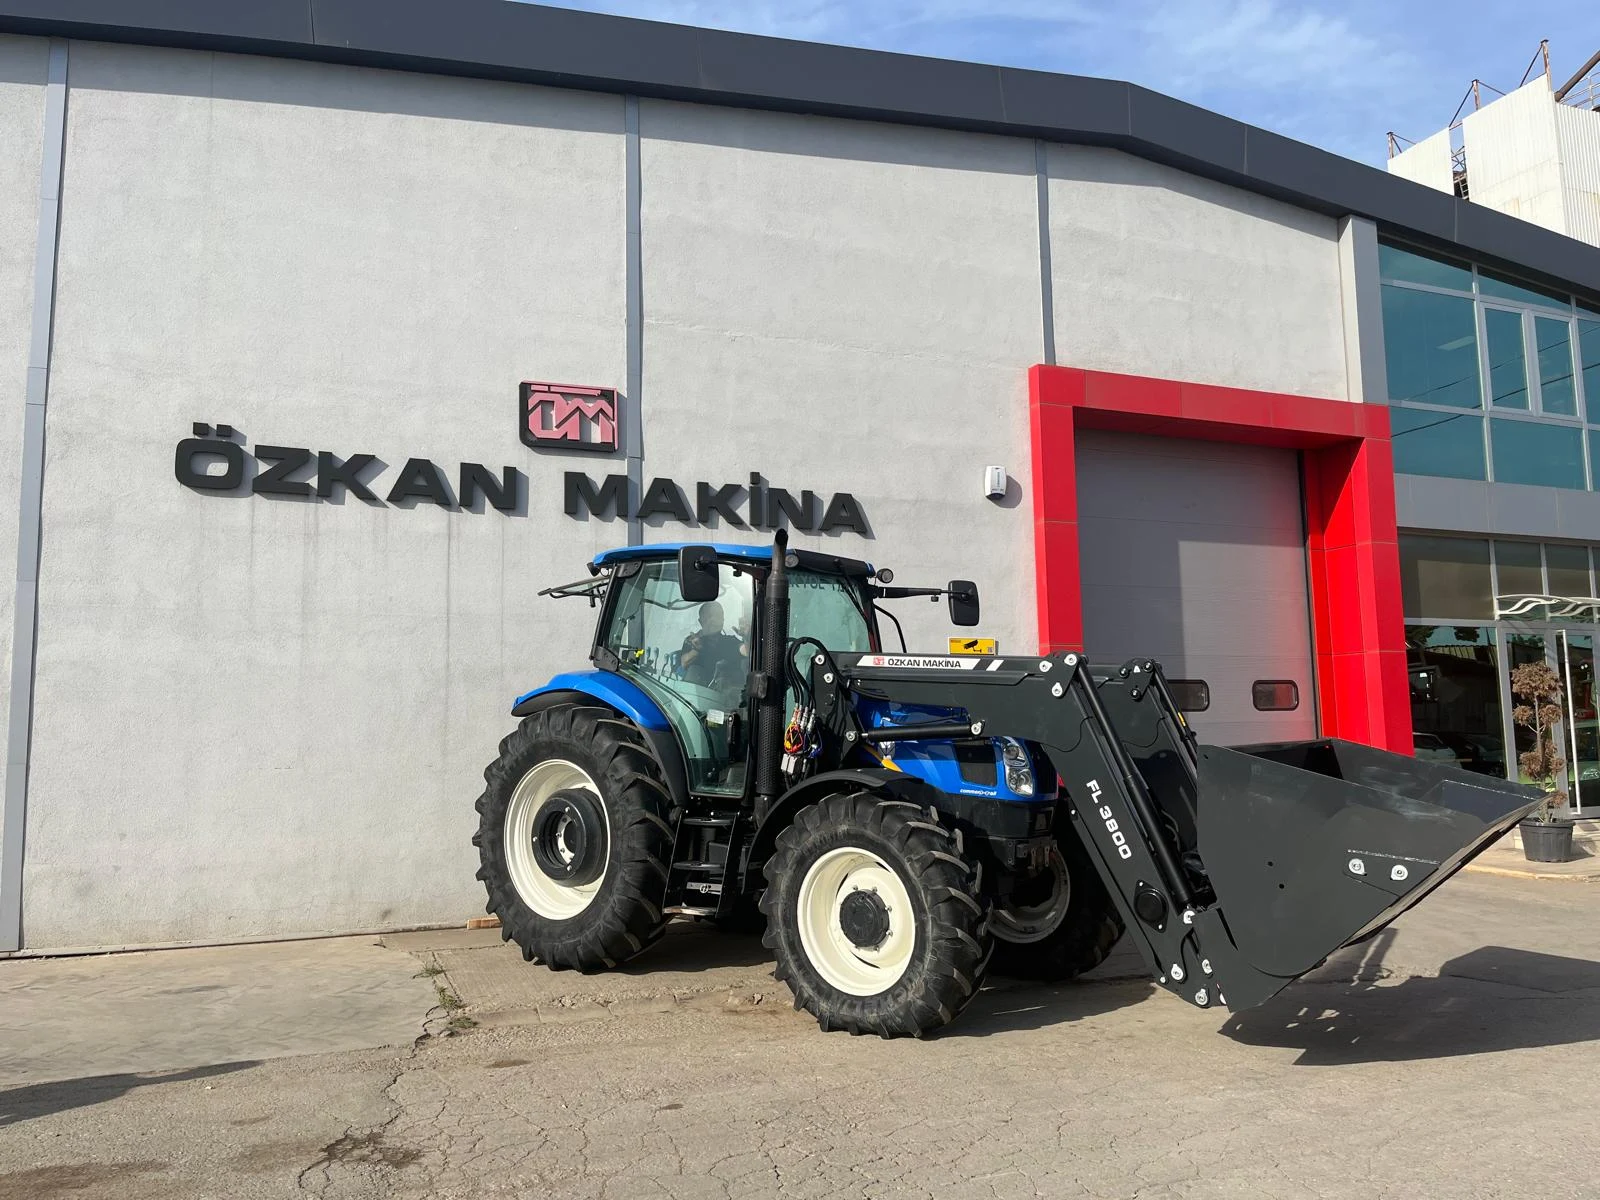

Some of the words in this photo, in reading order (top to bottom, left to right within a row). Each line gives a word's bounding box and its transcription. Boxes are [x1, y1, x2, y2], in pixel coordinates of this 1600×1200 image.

[174, 421, 517, 511] ÖZKAN
[564, 471, 869, 535] MAKİNA
[922, 658, 962, 669] MAKİNA
[1086, 779, 1102, 804] FL
[1099, 805, 1132, 860] 3800
